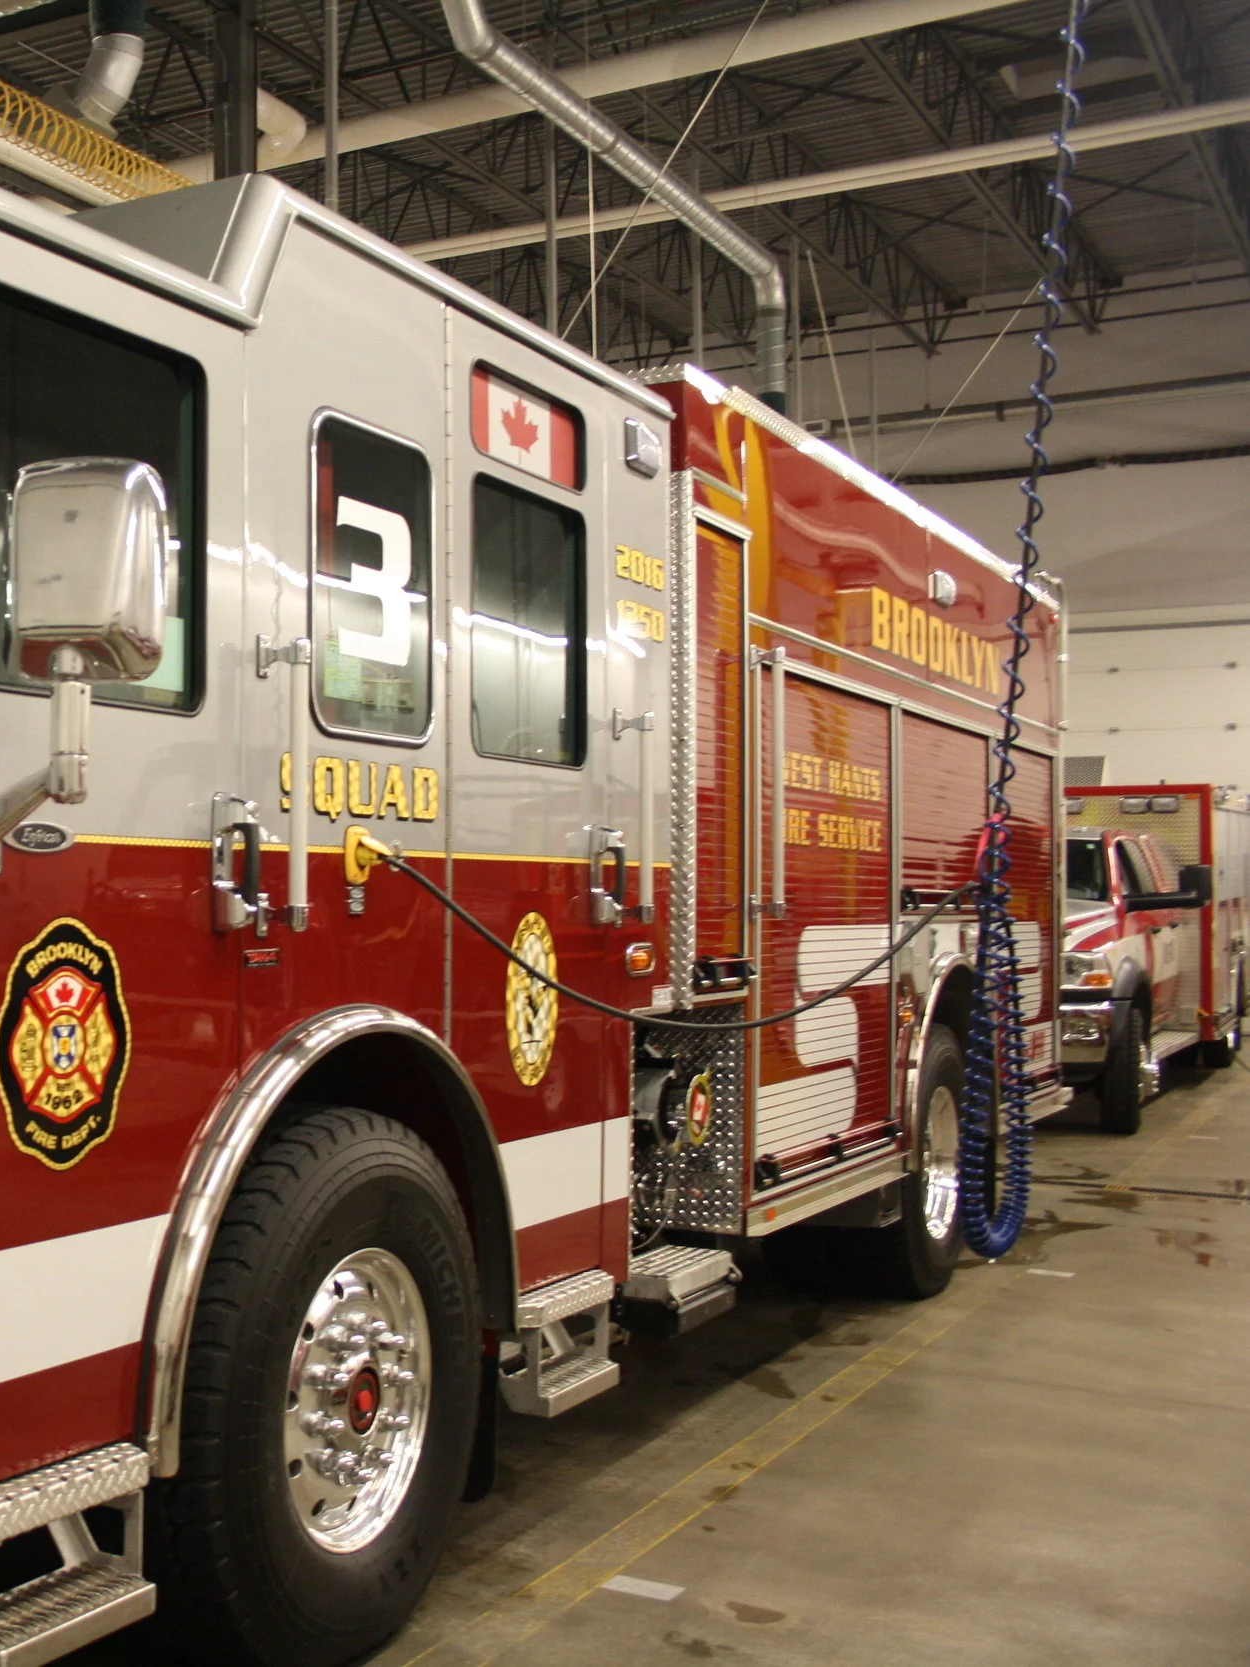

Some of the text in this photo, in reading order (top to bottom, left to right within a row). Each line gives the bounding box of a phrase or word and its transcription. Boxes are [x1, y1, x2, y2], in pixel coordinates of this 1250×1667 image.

[337, 495, 412, 666] 3
[615, 543, 665, 592] 2016
[871, 586, 1000, 695] BROOKLYN
[829, 760, 882, 801] HANTS
[783, 808, 883, 853] IRE SERVICE
[25, 941, 104, 979] BROOKLYN
[25, 1115, 102, 1150] FIRE DEPT.
